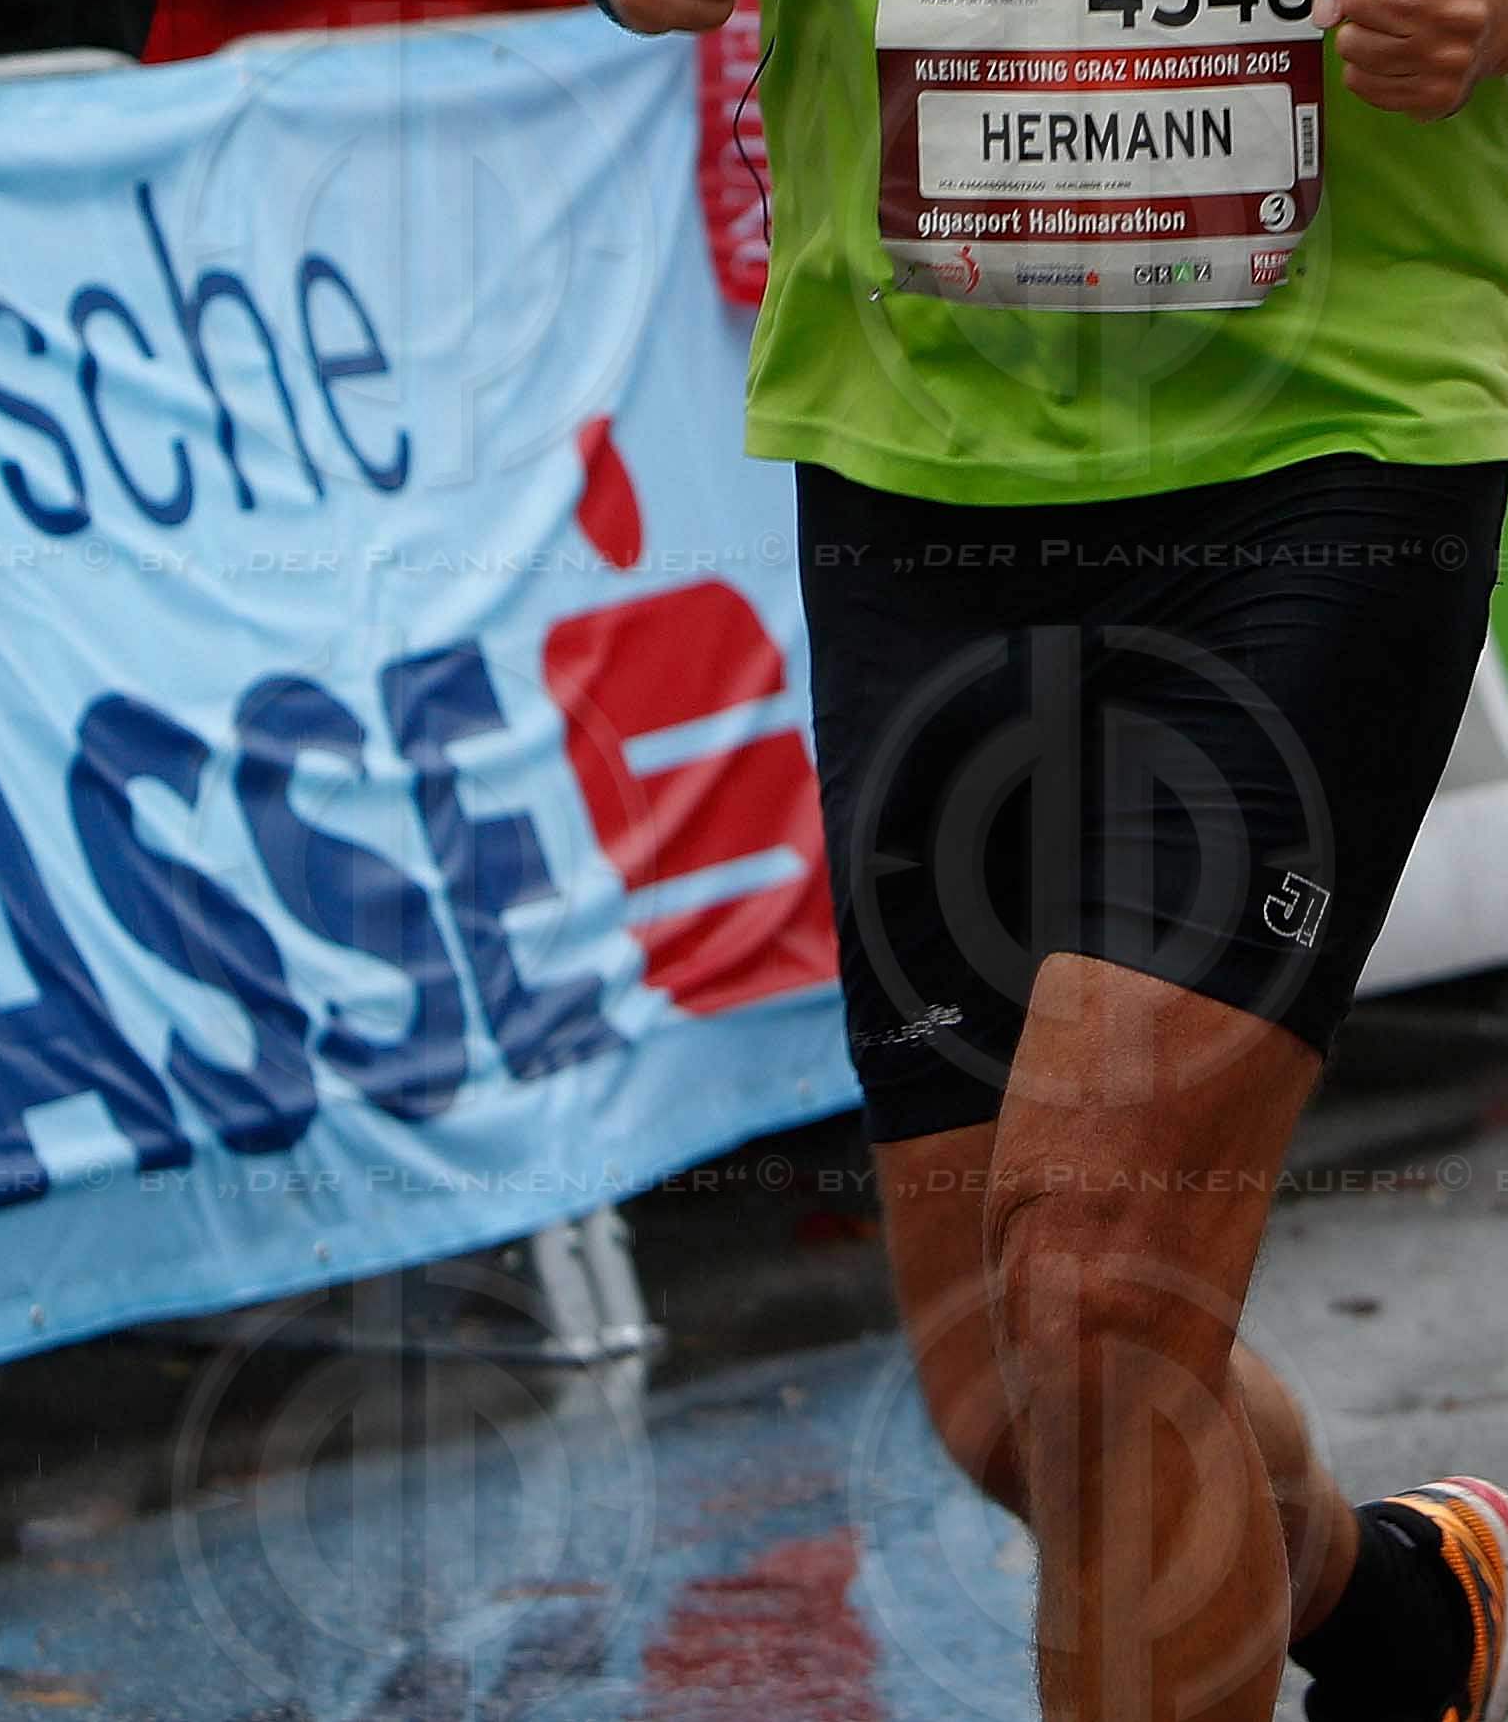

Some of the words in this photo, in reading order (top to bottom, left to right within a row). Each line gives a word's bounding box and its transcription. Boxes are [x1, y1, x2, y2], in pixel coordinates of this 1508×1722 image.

[915, 58, 982, 82] KLEINE
[986, 58, 1068, 83] ZEITUNG
[1074, 58, 1127, 82] GRAZ
[1133, 53, 1240, 81] MARATHON
[1245, 50, 1291, 76] 2015
[980, 106, 1234, 163] HERMANN
[917, 206, 1022, 238] gigasport
[1029, 206, 1187, 235] Halbmarathon
